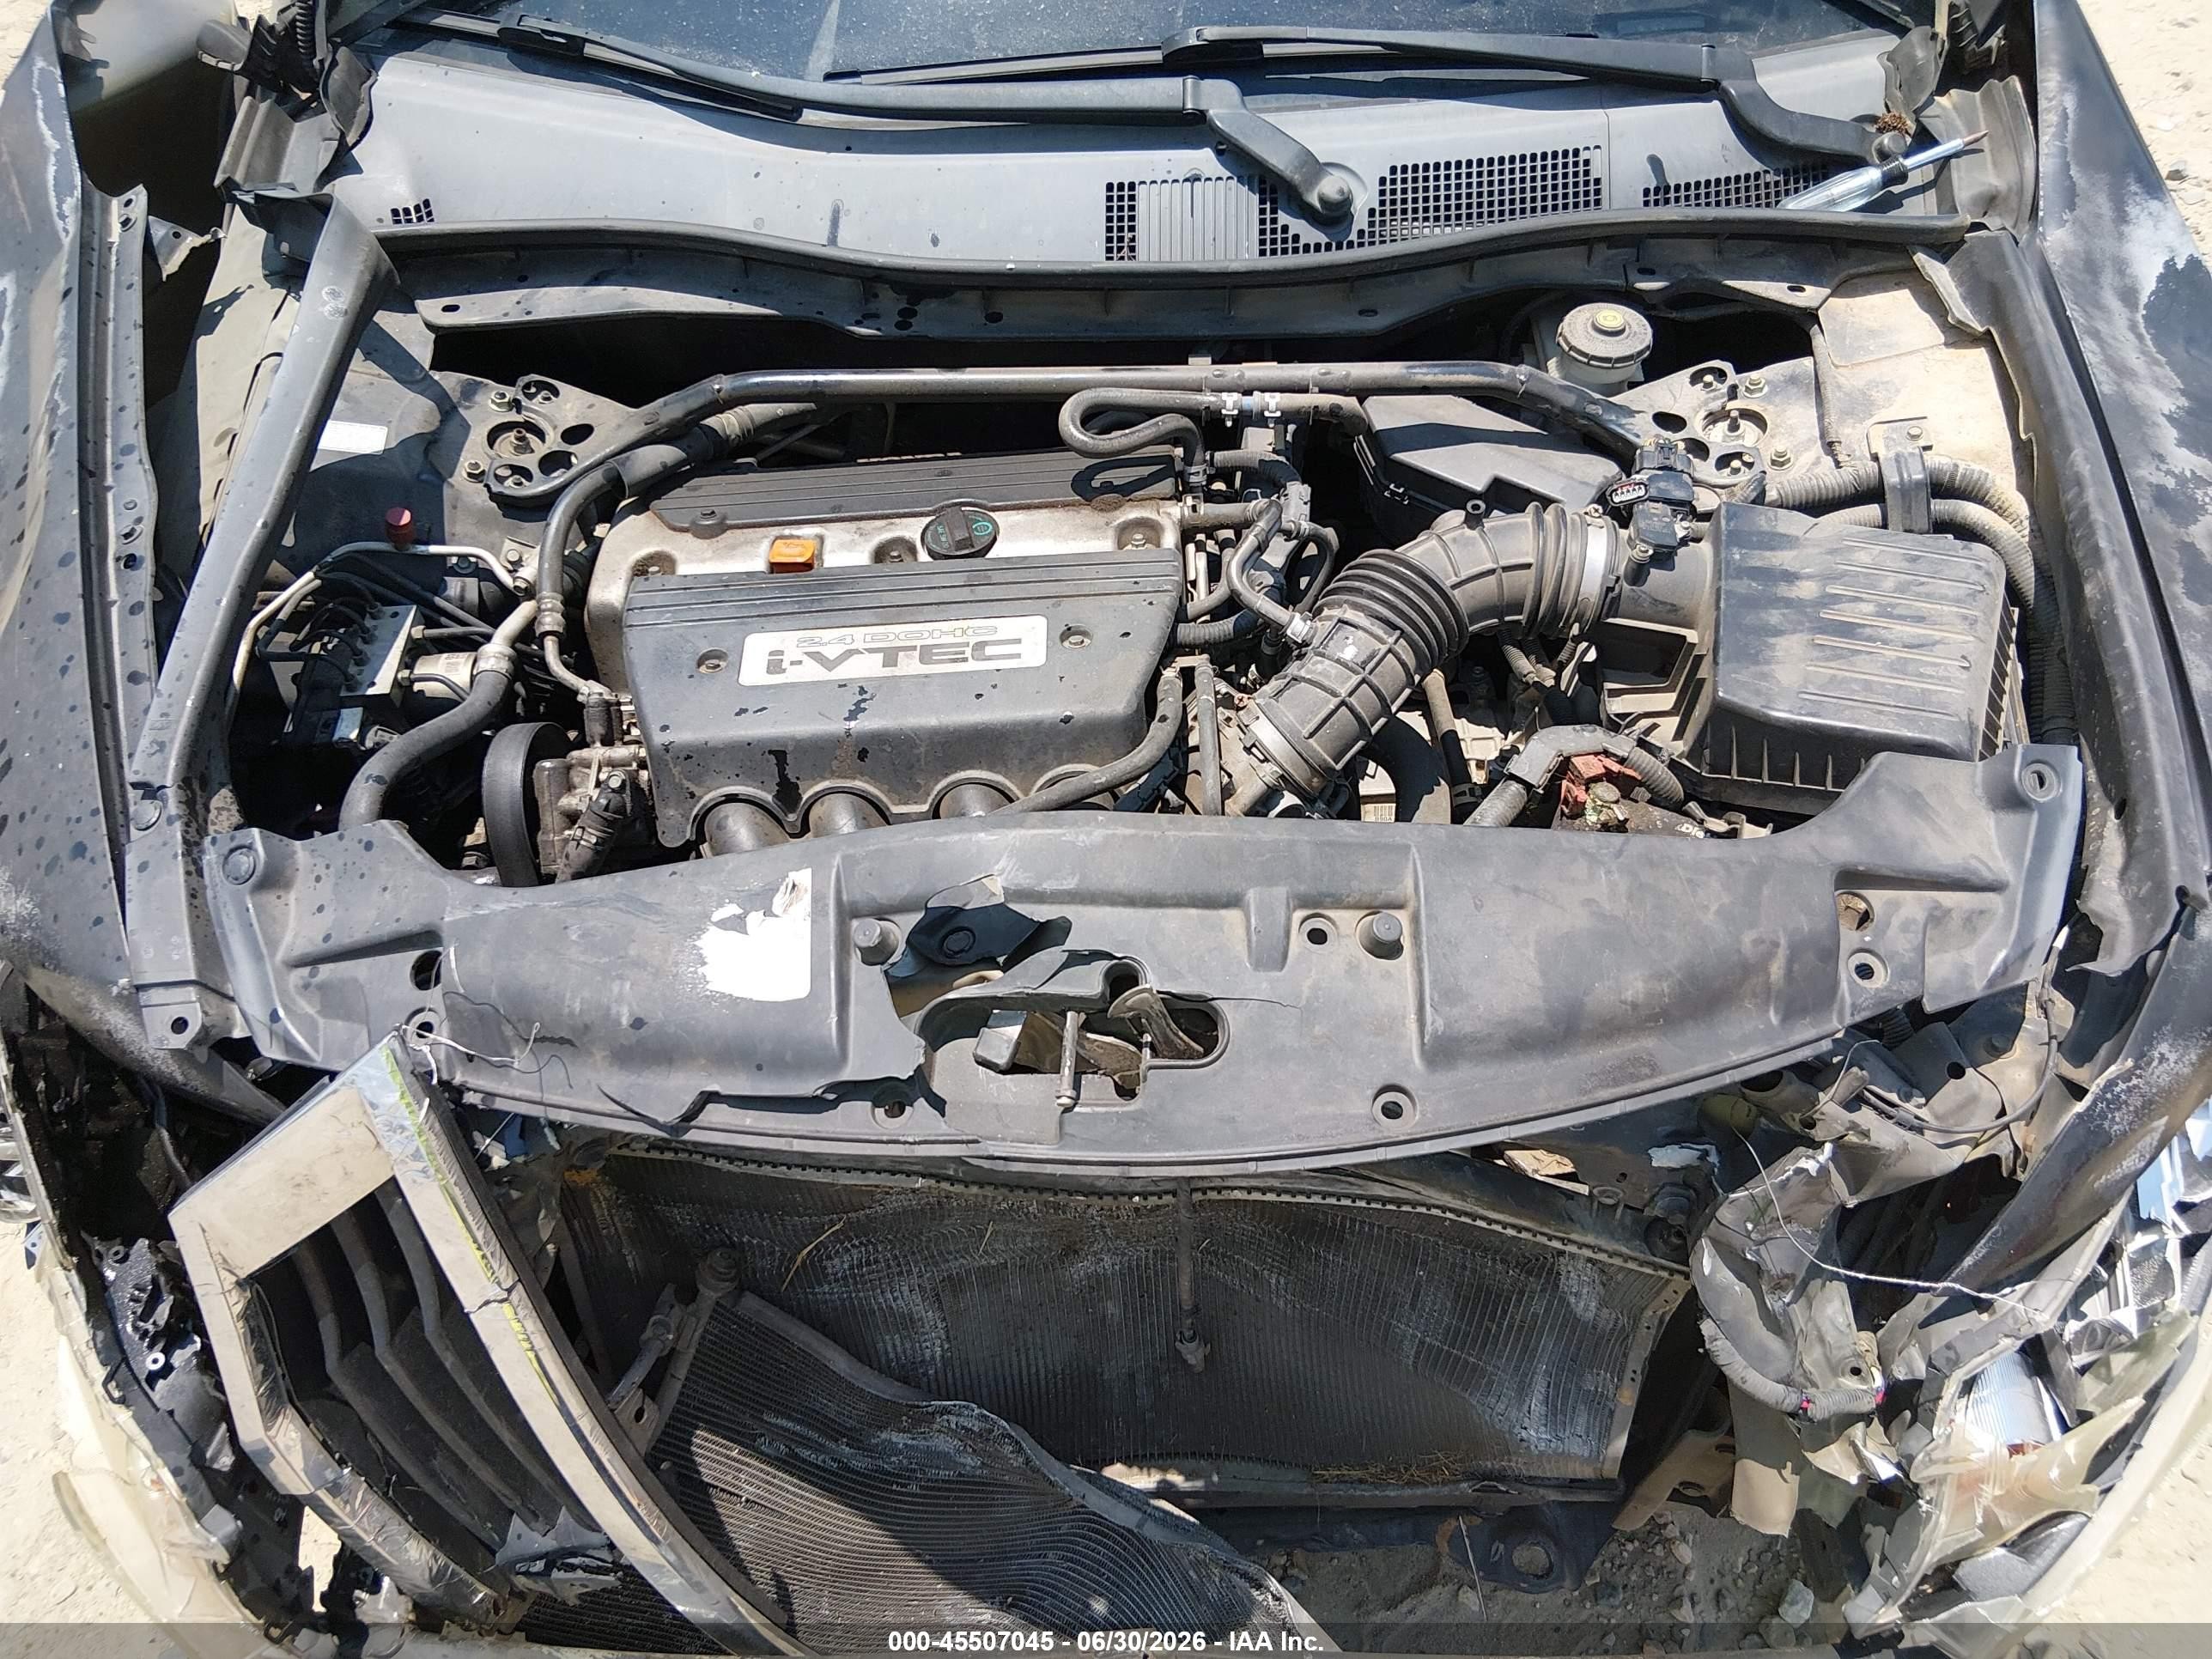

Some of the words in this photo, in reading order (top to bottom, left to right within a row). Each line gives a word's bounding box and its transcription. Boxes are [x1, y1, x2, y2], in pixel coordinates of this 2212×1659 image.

[797, 634, 854, 647] 2.4
[863, 625, 998, 644] DOHC
[766, 638, 1022, 676] i-VTEC
